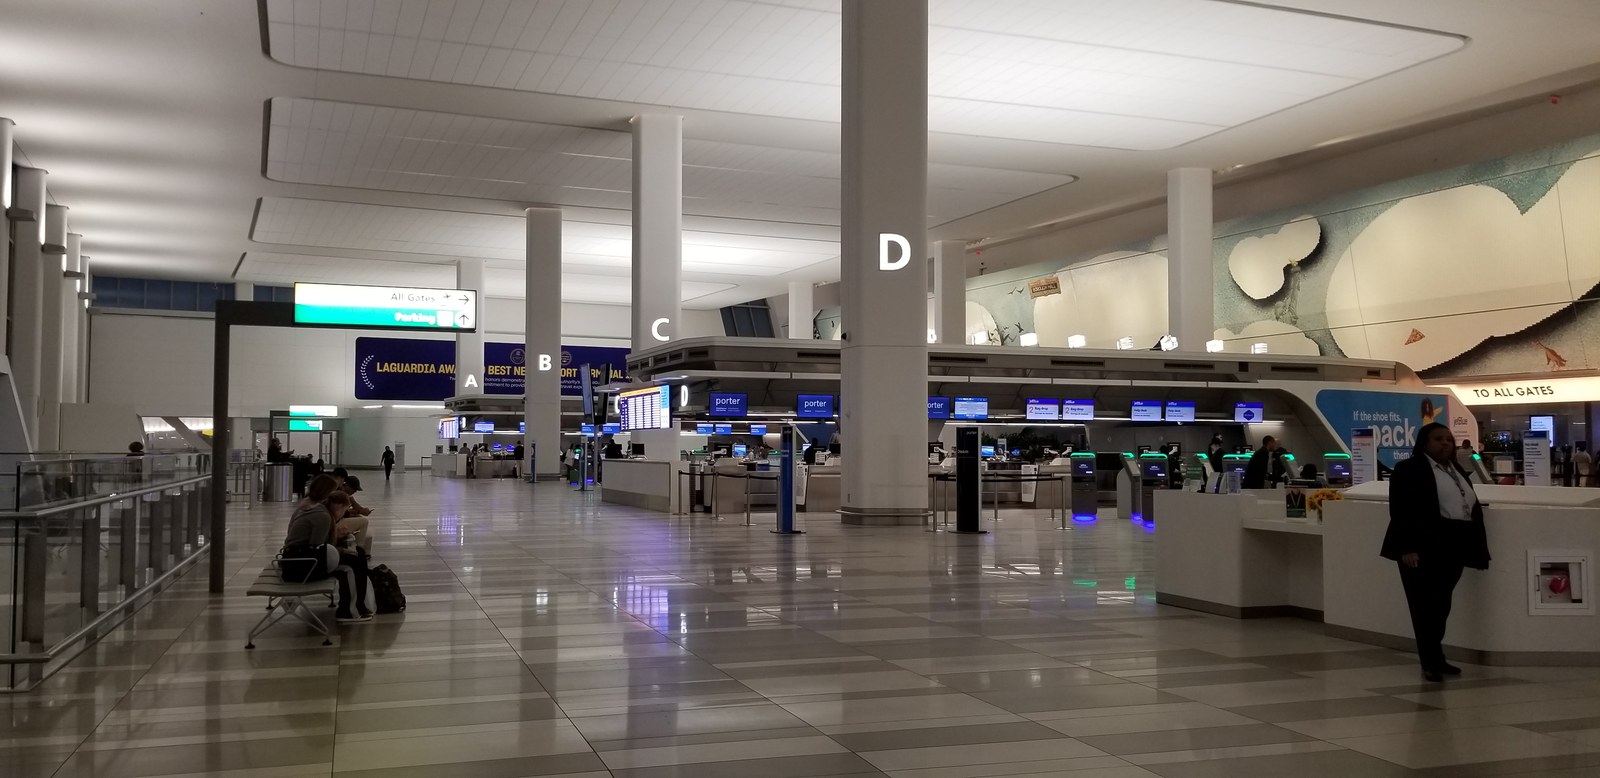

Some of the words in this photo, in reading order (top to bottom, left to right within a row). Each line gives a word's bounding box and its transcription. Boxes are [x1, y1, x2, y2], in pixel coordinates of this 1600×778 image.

[879, 232, 911, 271] D
[391, 293, 403, 301] All
[407, 293, 435, 302] Gates
[651, 317, 670, 341] C
[376, 362, 436, 374] LAGUARDIA
[488, 365, 511, 375] BEST
[539, 354, 552, 371] B
[464, 374, 479, 388] A
[1473, 389, 1489, 398] TO
[1494, 387, 1513, 397] ALL
[1516, 385, 1554, 396] GATES
[715, 397, 741, 406] porter
[804, 400, 827, 408] porter
[928, 401, 944, 409] orter
[1353, 411, 1359, 420] If
[1360, 411, 1371, 421] the
[1373, 412, 1388, 421] shoe
[1389, 412, 1402, 423] fits,
[1368, 417, 1416, 447] pack
[1393, 450, 1410, 460] them
